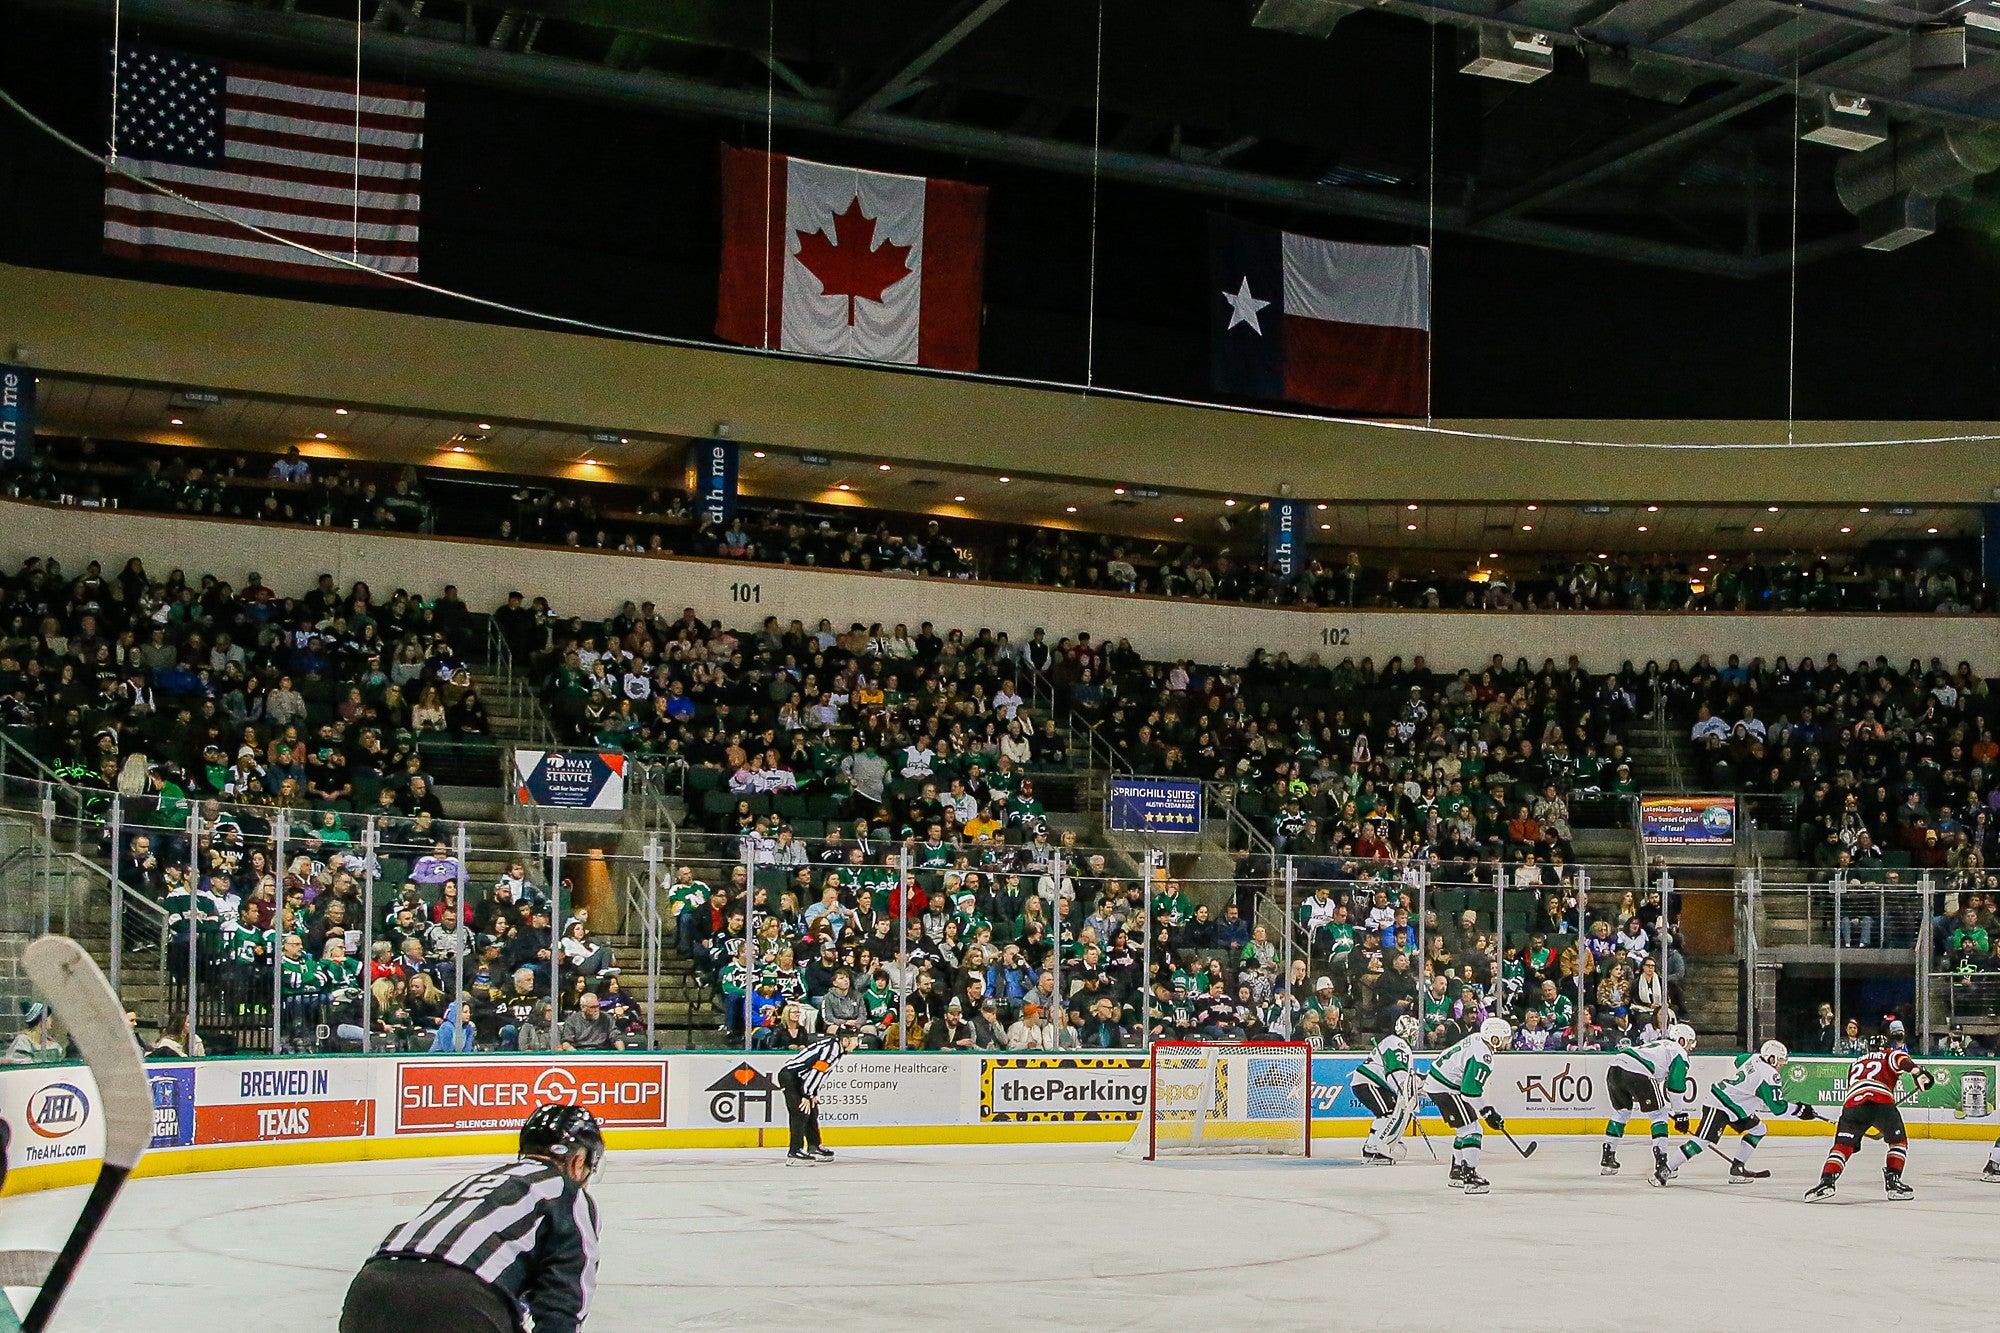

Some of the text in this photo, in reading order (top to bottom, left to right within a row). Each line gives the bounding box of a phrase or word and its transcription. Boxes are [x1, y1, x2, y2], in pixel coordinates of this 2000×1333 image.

[730, 582, 760, 604] 101
[1319, 627, 1350, 646] 102
[566, 759, 592, 769] WAY
[545, 773, 593, 783] SERVICE
[1113, 787, 1196, 800] SPRINGHILL SUITES
[496, 1002, 507, 1013] 23
[1395, 1051, 1410, 1064] 35
[847, 1062, 858, 1073] of
[860, 1063, 891, 1073] Home
[893, 1063, 948, 1073] Healthcare
[1849, 1060, 1883, 1087] 22
[240, 1069, 329, 1097] BREWED IN
[1474, 1068, 1487, 1083] 11
[850, 1079, 898, 1091] Company
[1000, 1079, 1148, 1106] theParking
[1896, 1079, 1904, 1091] &
[403, 1081, 660, 1109] SILENCER SHOP
[1771, 1088, 1783, 1101] 12
[36, 1094, 78, 1124] AHL
[257, 1107, 311, 1136] TEXAS
[455, 1117, 530, 1129] SILENCER OWNE
[153, 1122, 179, 1137] IGHT
[26, 1144, 87, 1161] TheAHL.com
